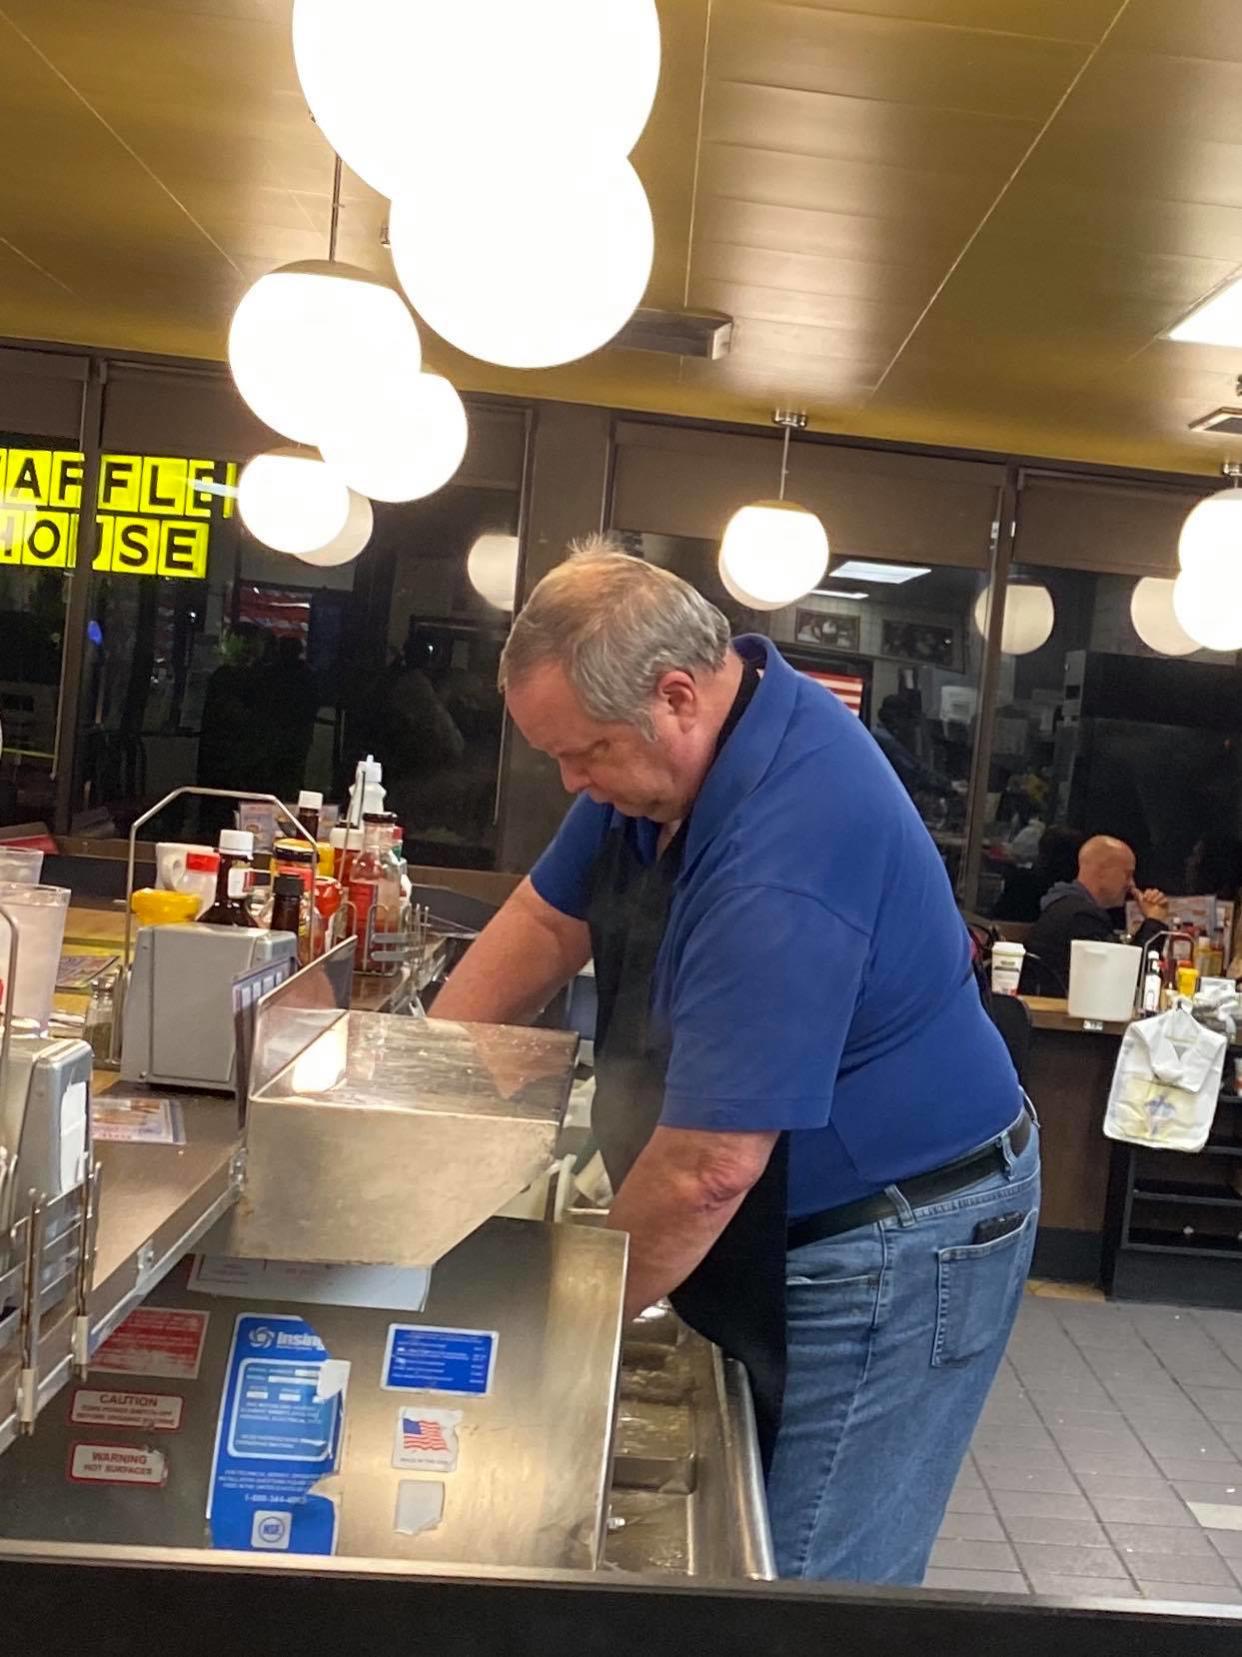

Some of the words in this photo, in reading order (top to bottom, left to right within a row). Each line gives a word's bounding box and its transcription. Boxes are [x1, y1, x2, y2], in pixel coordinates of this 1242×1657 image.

[0, 455, 214, 512] AFFLE
[100, 1394, 158, 1407] CAUTION
[92, 1452, 147, 1465] WARNING
